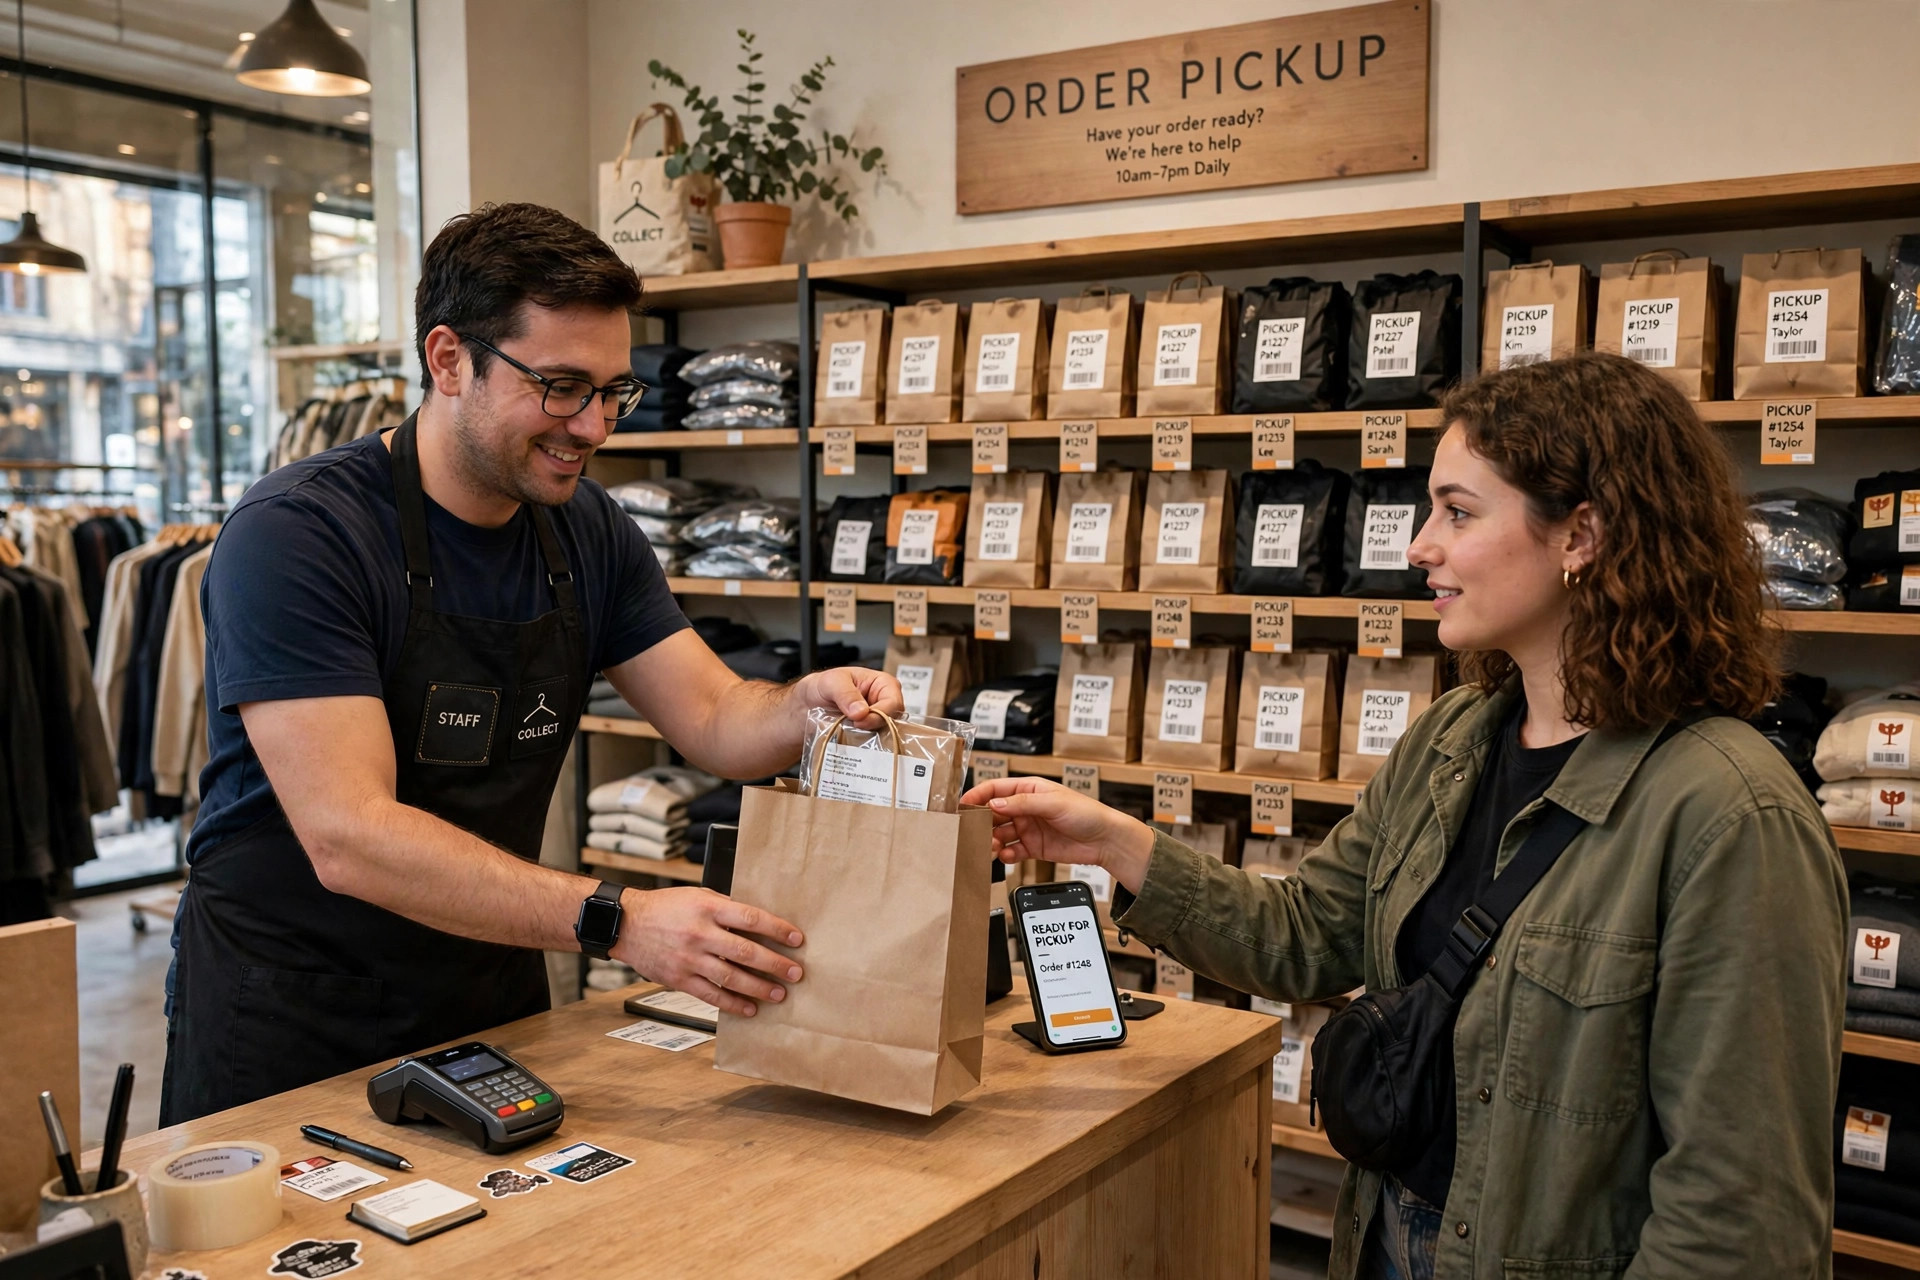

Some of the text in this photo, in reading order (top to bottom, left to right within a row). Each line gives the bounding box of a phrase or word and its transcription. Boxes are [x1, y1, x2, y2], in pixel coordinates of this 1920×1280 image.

[984, 34, 1387, 123] ORDER PICKUP
[1086, 108, 1264, 143] Have your order ready?
[1105, 135, 1241, 163] We're here to help
[1194, 159, 1231, 180] Daily
[613, 228, 664, 244] COLLECT
[1773, 294, 1823, 308] PICKUP
[1506, 309, 1548, 322] PICKUP
[1628, 302, 1674, 317] PICKUP
[1375, 316, 1414, 329] PICKUP
[1772, 310, 1809, 323] #1254
[1262, 322, 1299, 334] PICKUP
[1505, 324, 1537, 336] #1219
[1627, 318, 1660, 331] #1219
[1071, 333, 1103, 344] PICKUP
[1161, 328, 1197, 339] PICKUP
[1373, 331, 1403, 342] #1227
[1626, 333, 1646, 345] Kim
[1771, 327, 1804, 340] Taylor
[905, 340, 935, 350] PICKUP
[983, 337, 1015, 347] PICKUP
[1261, 337, 1289, 348] #1227
[1504, 339, 1523, 350] Kim
[1372, 344, 1395, 355] Patel
[1766, 404, 1812, 417] PICKUP
[1155, 421, 1189, 431] PICKUP
[1255, 418, 1291, 429] PICKUP
[1365, 415, 1402, 426] PICKUP
[1768, 420, 1805, 432] #1254
[975, 426, 1005, 436] PICKUP
[1063, 424, 1095, 434] PICKUP
[1367, 430, 1397, 441] #1248
[1367, 444, 1394, 455] Sarah
[1768, 436, 1803, 451] Taylor
[987, 506, 1019, 517] PICKUP
[1074, 507, 1107, 518] PICKUP
[1164, 507, 1199, 519] PICKUP
[1260, 508, 1298, 520] PICKUP
[1370, 509, 1409, 521] PICKUP
[1367, 536, 1391, 547] Patel
[977, 592, 1007, 603] PICKUP
[1064, 596, 1095, 607] PICKUP
[1154, 598, 1188, 609] PICKUP
[1254, 601, 1289, 612] PICKUP
[1361, 604, 1399, 616] PICKUP
[1365, 633, 1392, 644] Sarah
[1076, 679, 1109, 691] PICKUP
[1167, 684, 1202, 696] PICKUP
[1262, 690, 1299, 703] PICKUP
[1365, 694, 1405, 706] PICKUP
[1261, 705, 1289, 716] #1233
[1364, 709, 1394, 720] #1233
[438, 711, 481, 728] STAFF
[517, 722, 560, 741] COLLECT
[1363, 722, 1389, 733] Sarah
[1065, 766, 1097, 777] PICKUP
[1156, 774, 1189, 786] PICKUP
[1254, 783, 1289, 796] PICKUP
[1031, 920, 1090, 935] READY FOR
[1035, 933, 1076, 948] PICKUP
[1040, 959, 1093, 973] Order #1248
